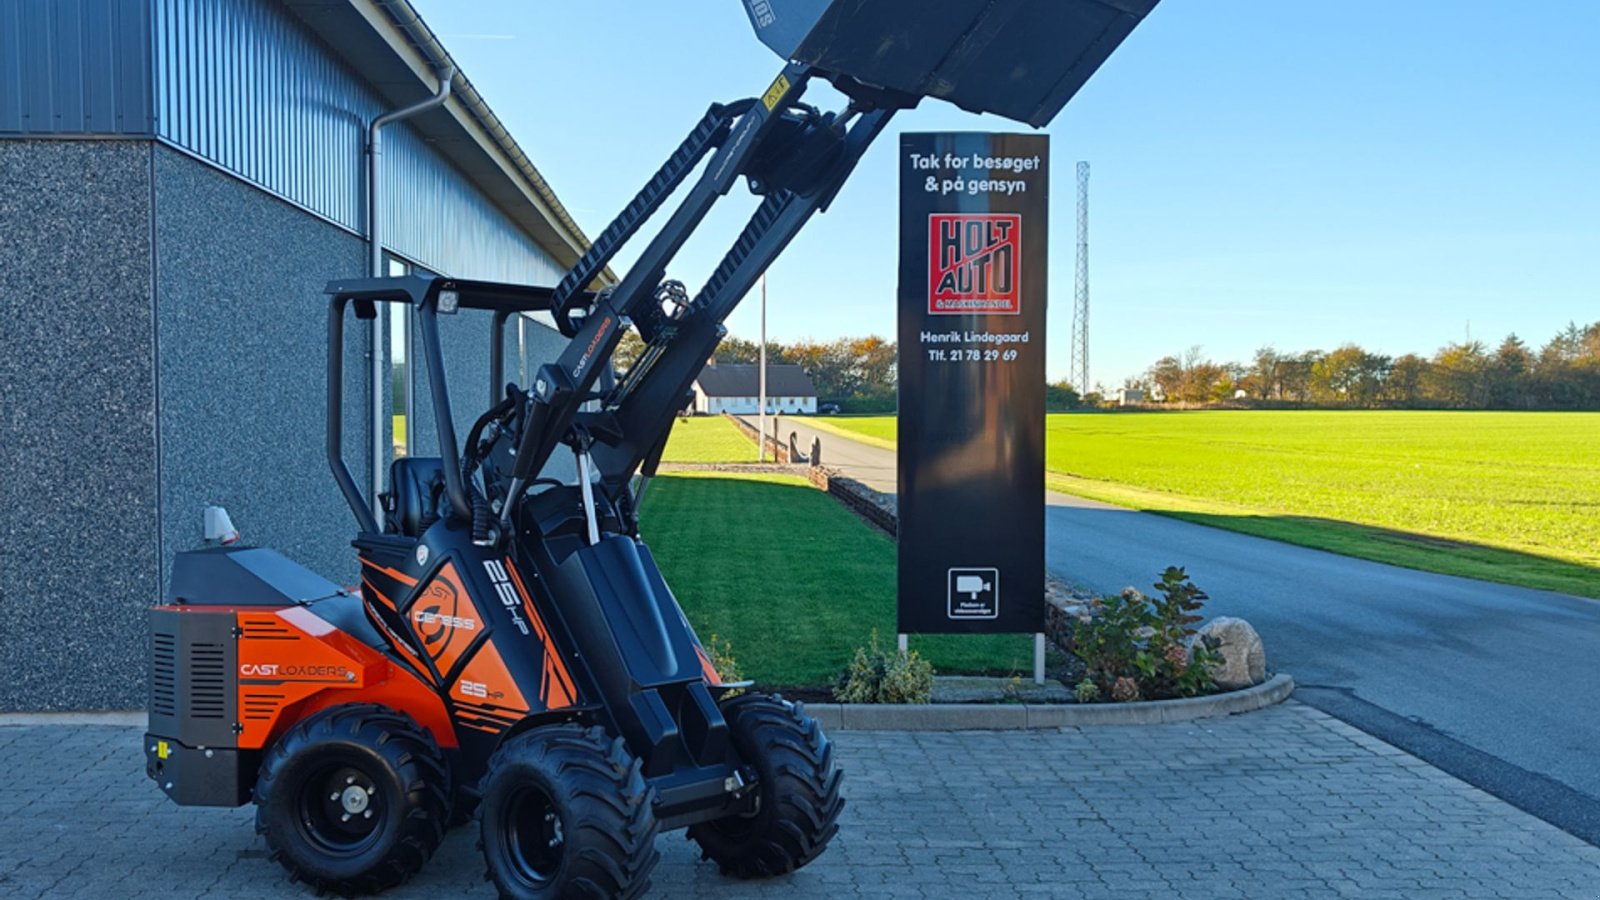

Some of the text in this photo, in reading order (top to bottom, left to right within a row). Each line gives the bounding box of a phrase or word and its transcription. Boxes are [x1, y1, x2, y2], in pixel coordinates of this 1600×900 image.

[910, 153, 1040, 173] Tak for besøget
[925, 176, 1026, 196] & på gensyn
[940, 220, 1013, 272] HOLT
[935, 241, 1013, 295] AUTO
[920, 331, 1029, 346] Henrik Lindegaard
[928, 349, 1018, 361] Tlf. 21 78 29 69
